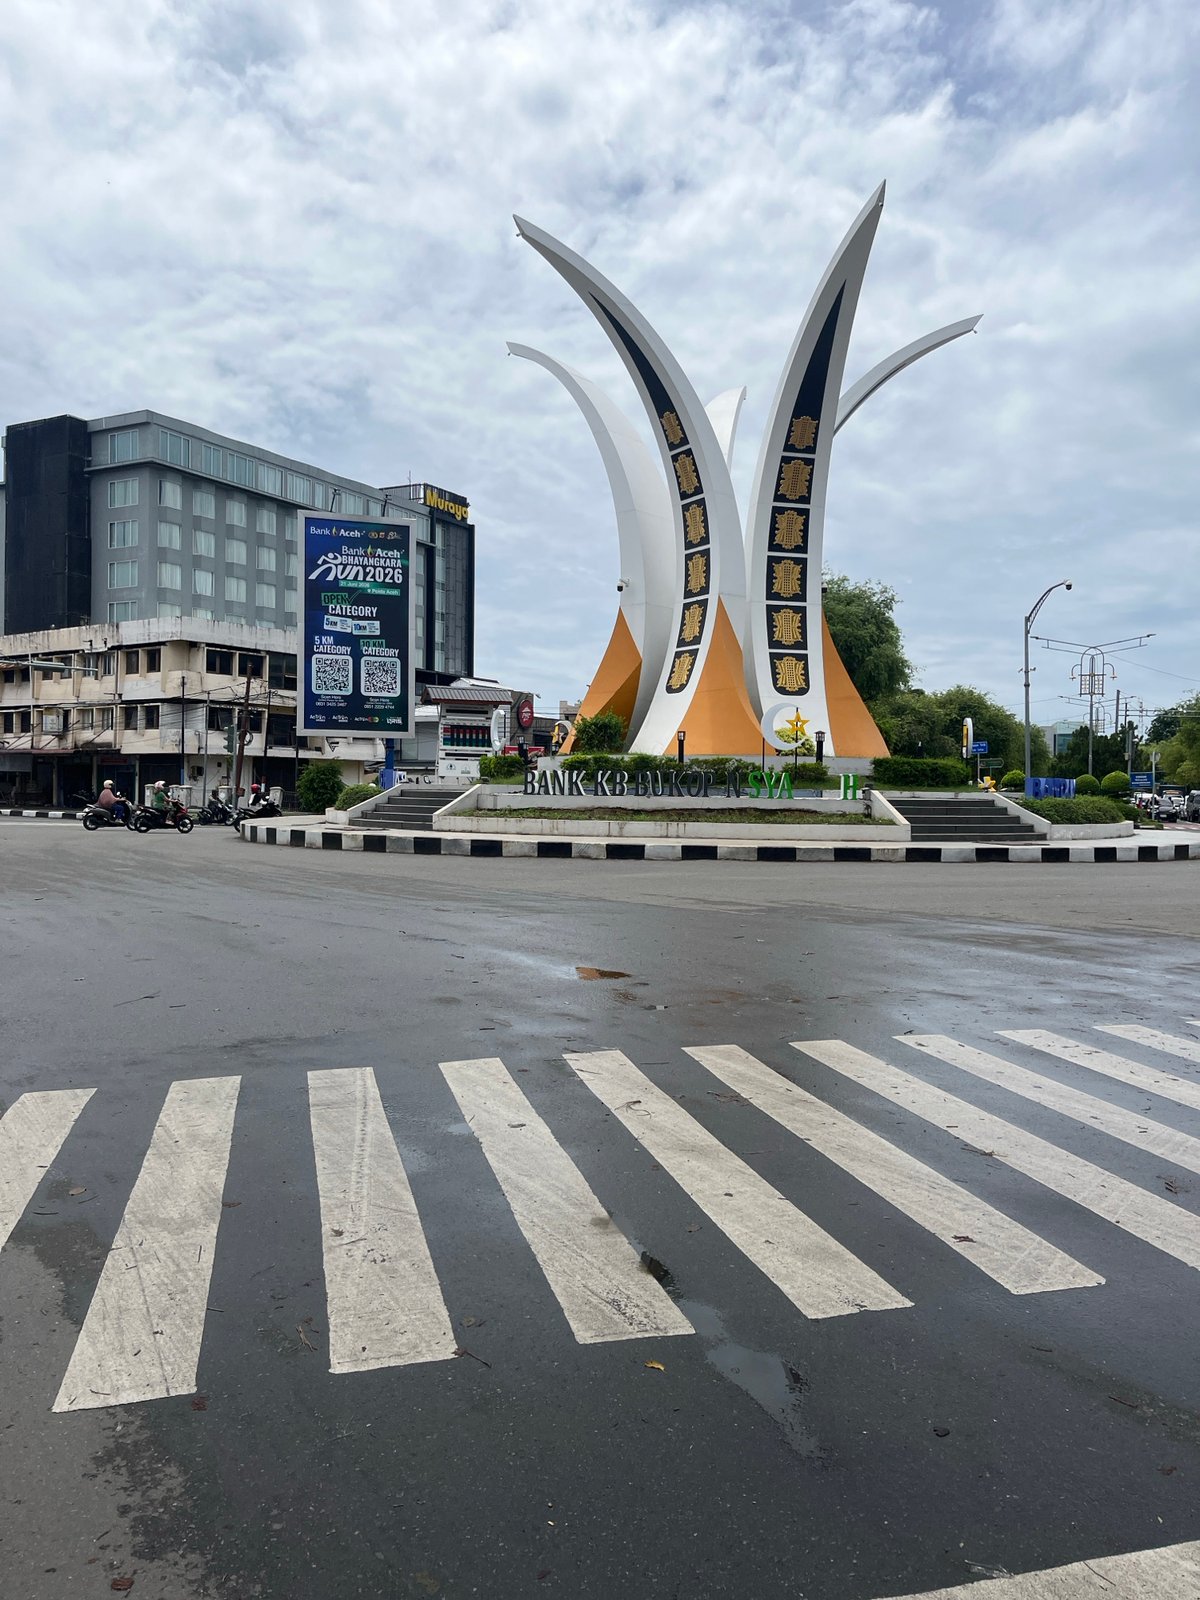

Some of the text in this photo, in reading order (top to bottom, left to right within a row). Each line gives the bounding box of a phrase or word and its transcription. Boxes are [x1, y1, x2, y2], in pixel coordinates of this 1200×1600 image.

[426, 489, 468, 521] Muraya
[310, 526, 360, 538] Bank Aceh
[342, 545, 401, 558] Bank Aceh
[342, 556, 402, 568] BHAYANGKARA
[365, 566, 403, 584] 2026
[323, 594, 348, 604] OPEN
[328, 604, 378, 618] CATEGORY
[325, 618, 330, 626] 5
[314, 635, 334, 645] 5 KM
[362, 640, 384, 648] 10 KM
[313, 645, 352, 655] CATEGORY
[362, 647, 400, 657] CATEGORY
[524, 770, 586, 796] BANK
[593, 770, 629, 796] KB
